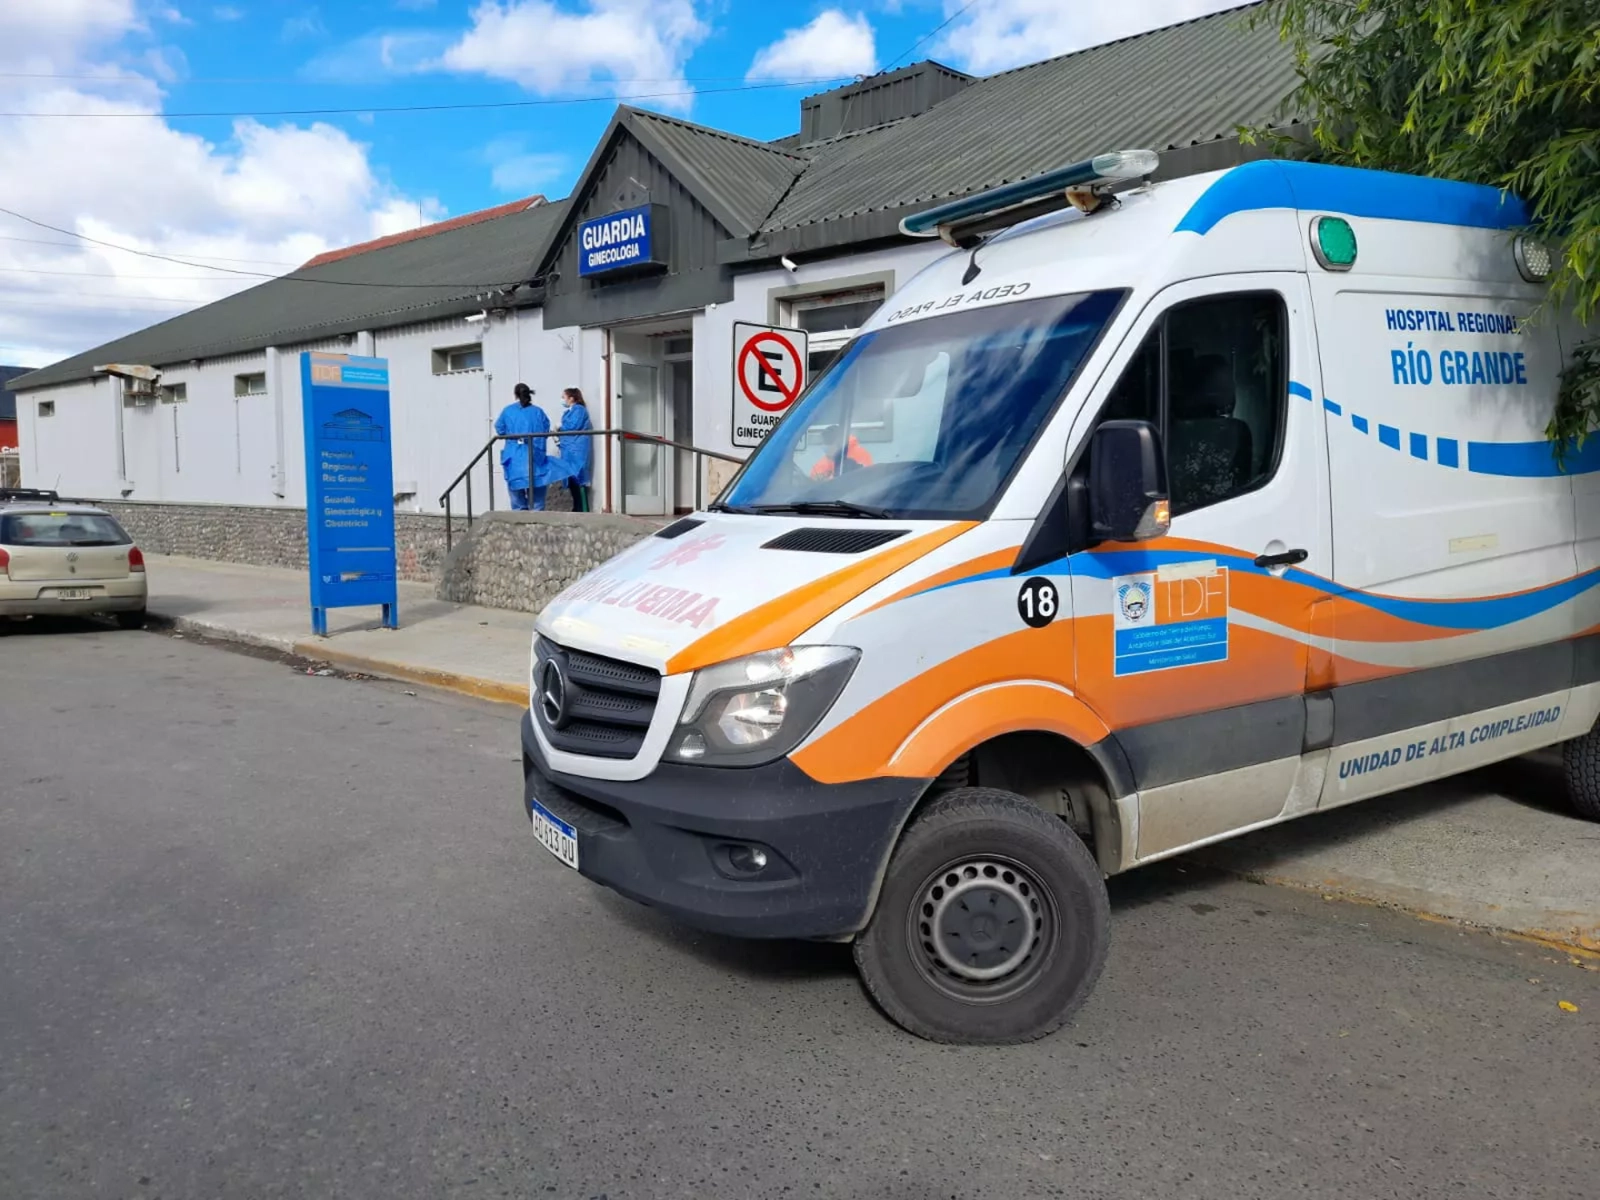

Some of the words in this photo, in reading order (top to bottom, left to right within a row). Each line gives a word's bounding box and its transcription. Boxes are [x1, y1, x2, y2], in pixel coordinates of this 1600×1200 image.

[582, 214, 646, 250] GUARDIA
[588, 242, 640, 267] GINECOLOGIA
[1385, 308, 1455, 332] HOSPITAL
[1390, 341, 1433, 386] RÍO
[1439, 350, 1528, 385] GRANDE
[737, 427, 770, 438] GINECO
[751, 414, 781, 426] GUARD
[323, 495, 356, 504] Guardia
[1020, 586, 1056, 618] 18
[1339, 748, 1401, 779] UNIDAD
[1405, 741, 1427, 762] DE
[1429, 731, 1466, 756] ALTA
[1469, 706, 1561, 745] COMPLEJIDAD
